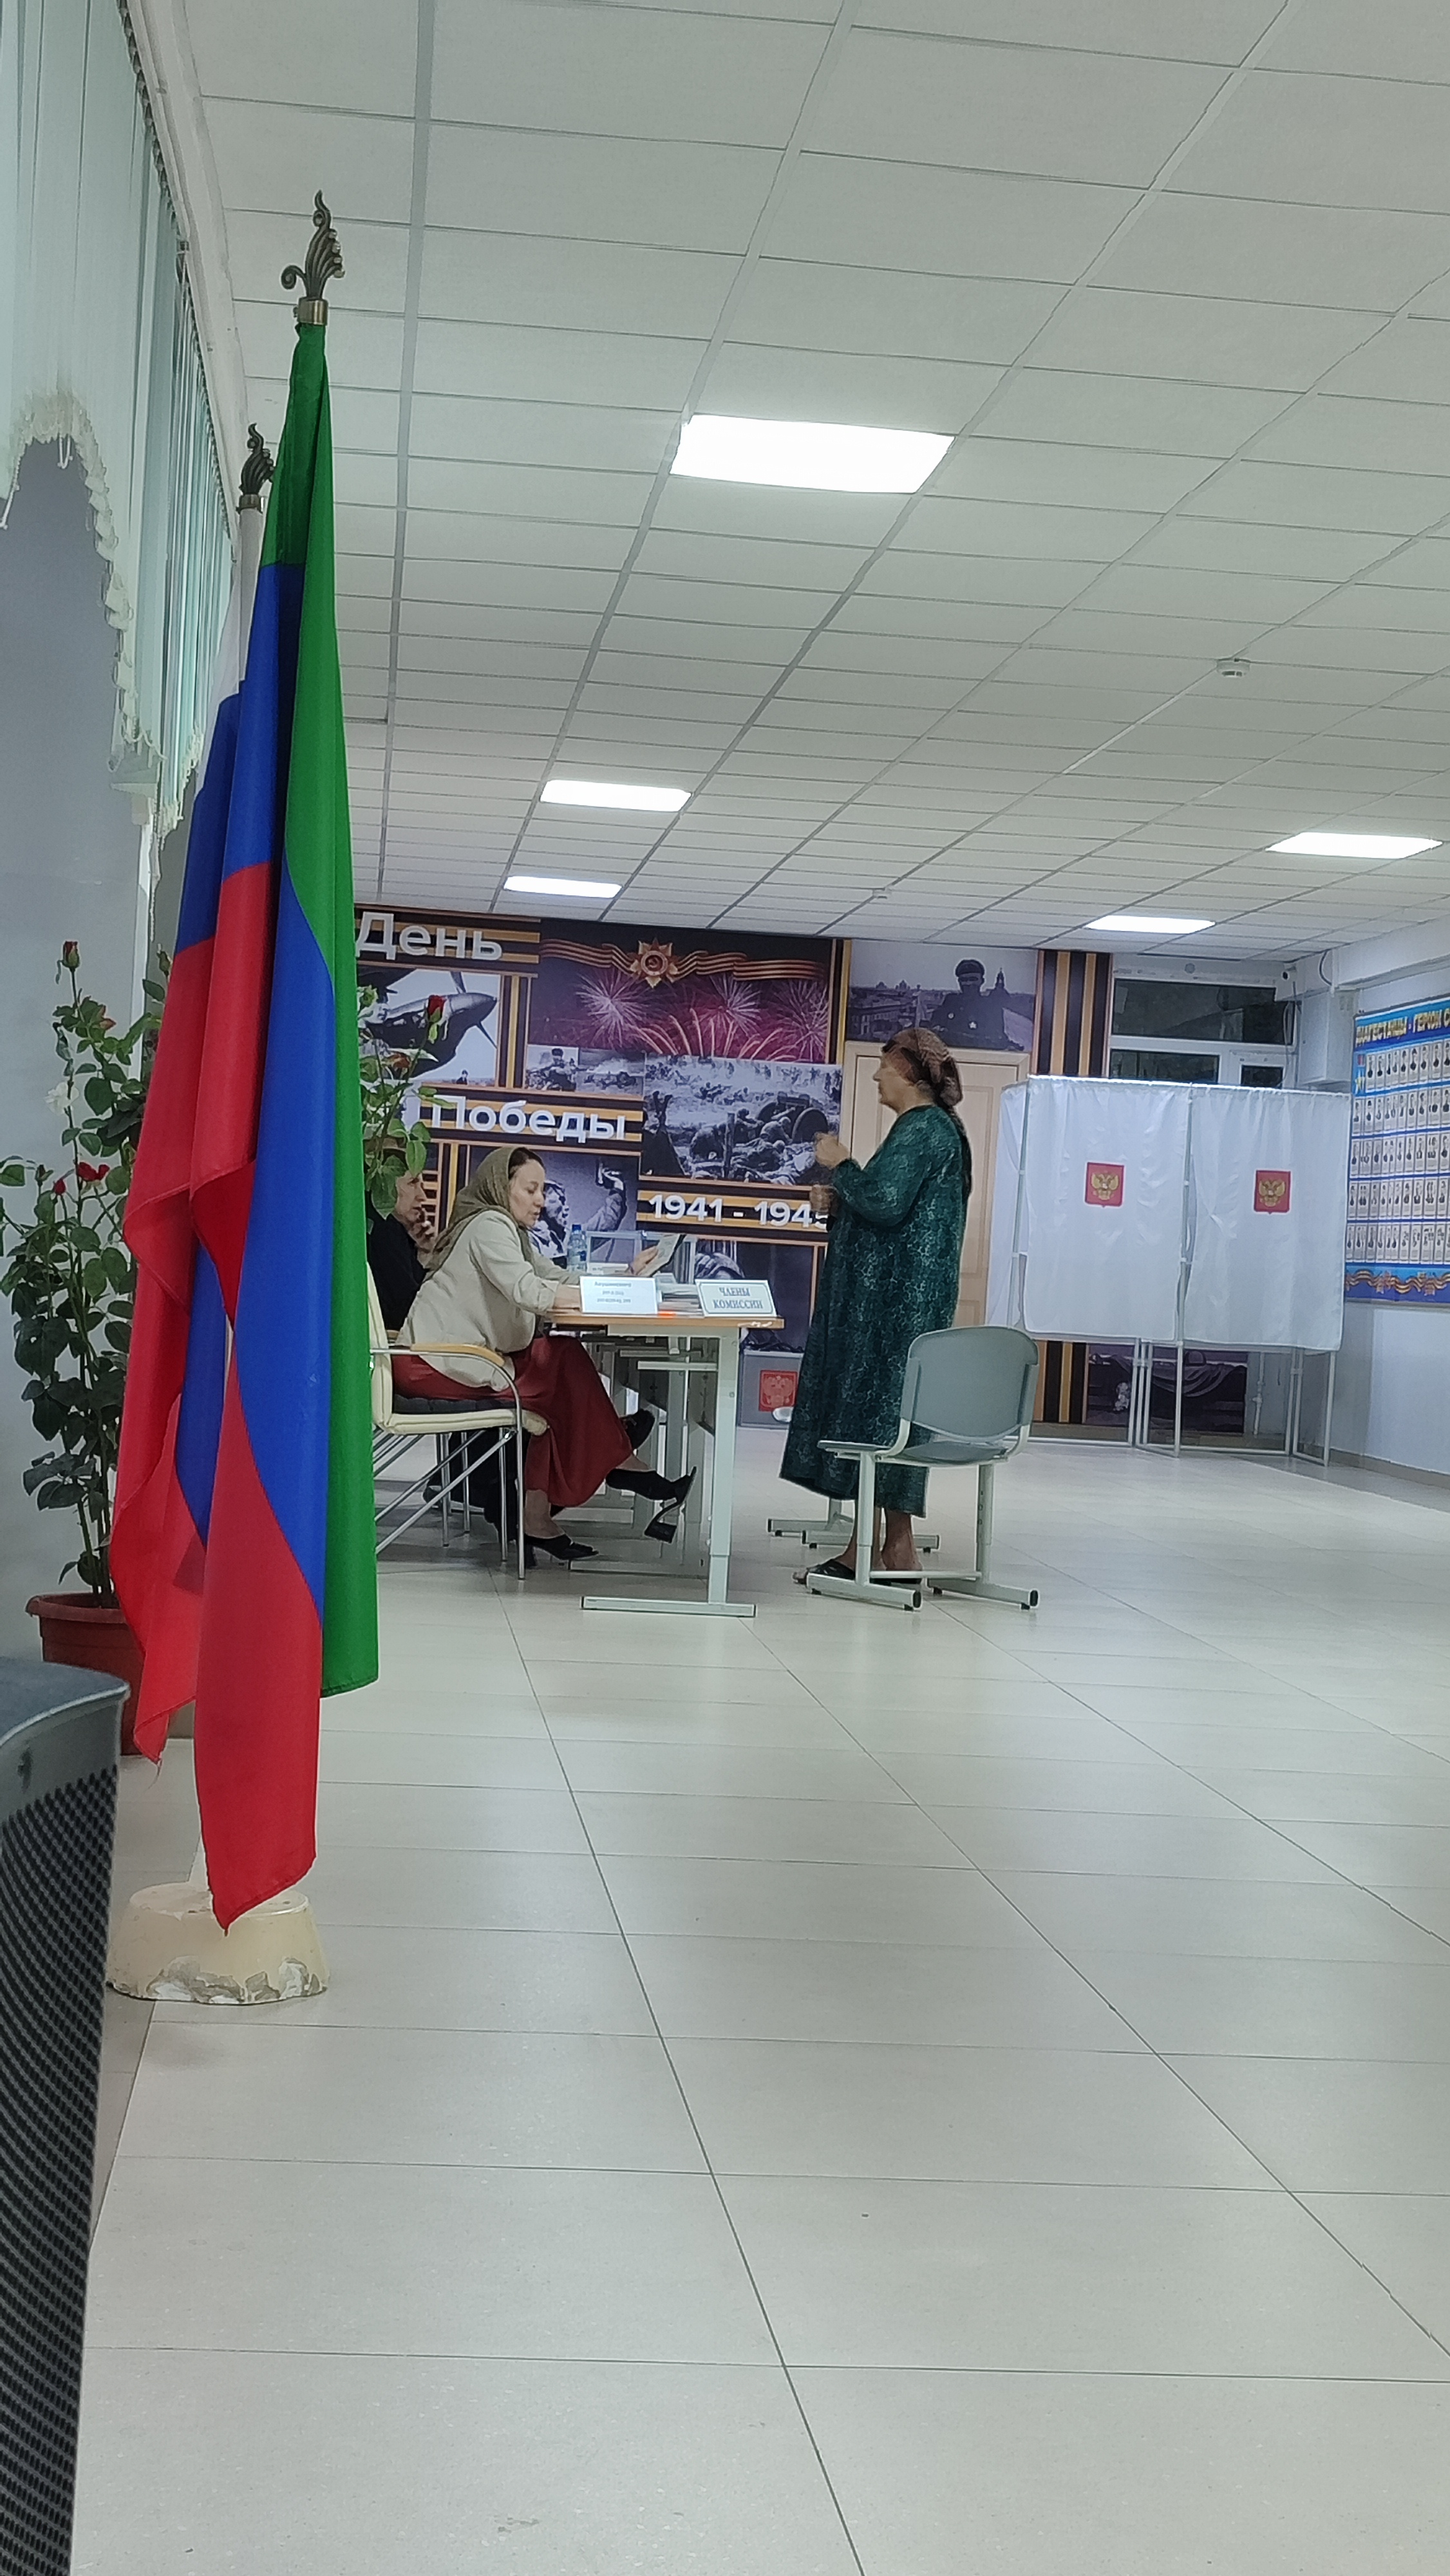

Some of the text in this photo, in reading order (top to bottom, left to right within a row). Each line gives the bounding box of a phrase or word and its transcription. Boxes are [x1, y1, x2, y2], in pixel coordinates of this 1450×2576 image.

[355, 911, 502, 961] День
[1412, 1009, 1442, 1034] ГЕРОИ
[431, 1094, 626, 1143] Победы
[648, 1194, 723, 1223] 1941
[713, 1300, 764, 1309] КОМИССИИ
[719, 1287, 751, 1296] ЧЛЕНЫ
